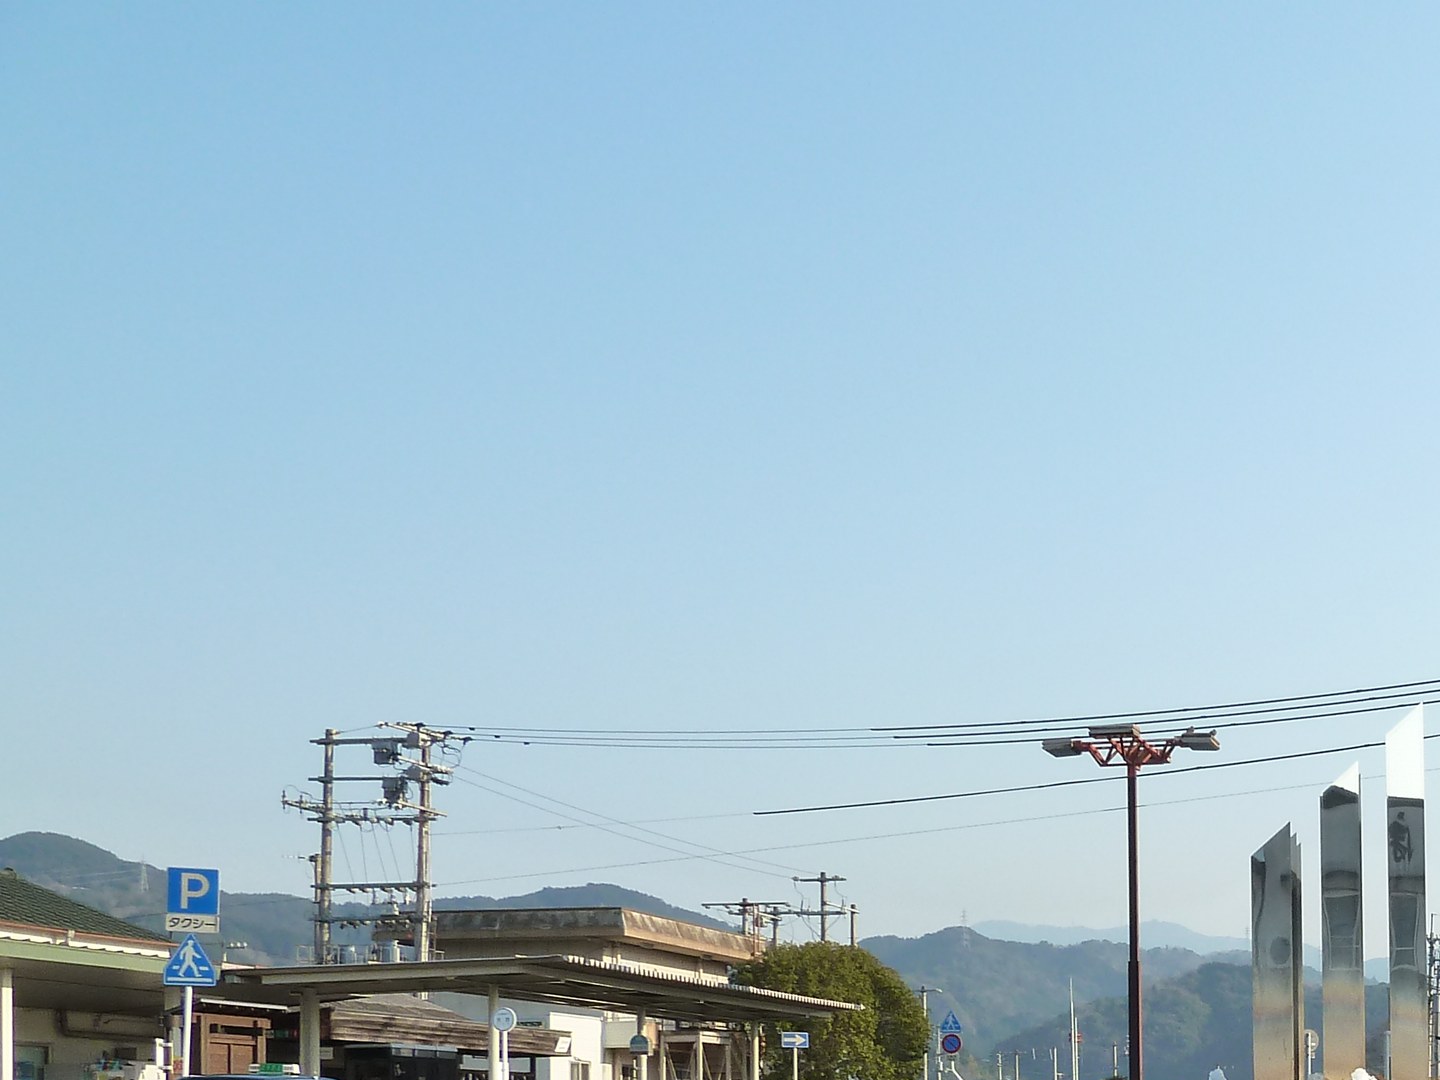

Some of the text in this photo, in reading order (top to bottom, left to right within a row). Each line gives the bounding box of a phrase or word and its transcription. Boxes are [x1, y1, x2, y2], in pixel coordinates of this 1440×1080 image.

[181, 872, 210, 909] P
[168, 917, 216, 929] タクシー
